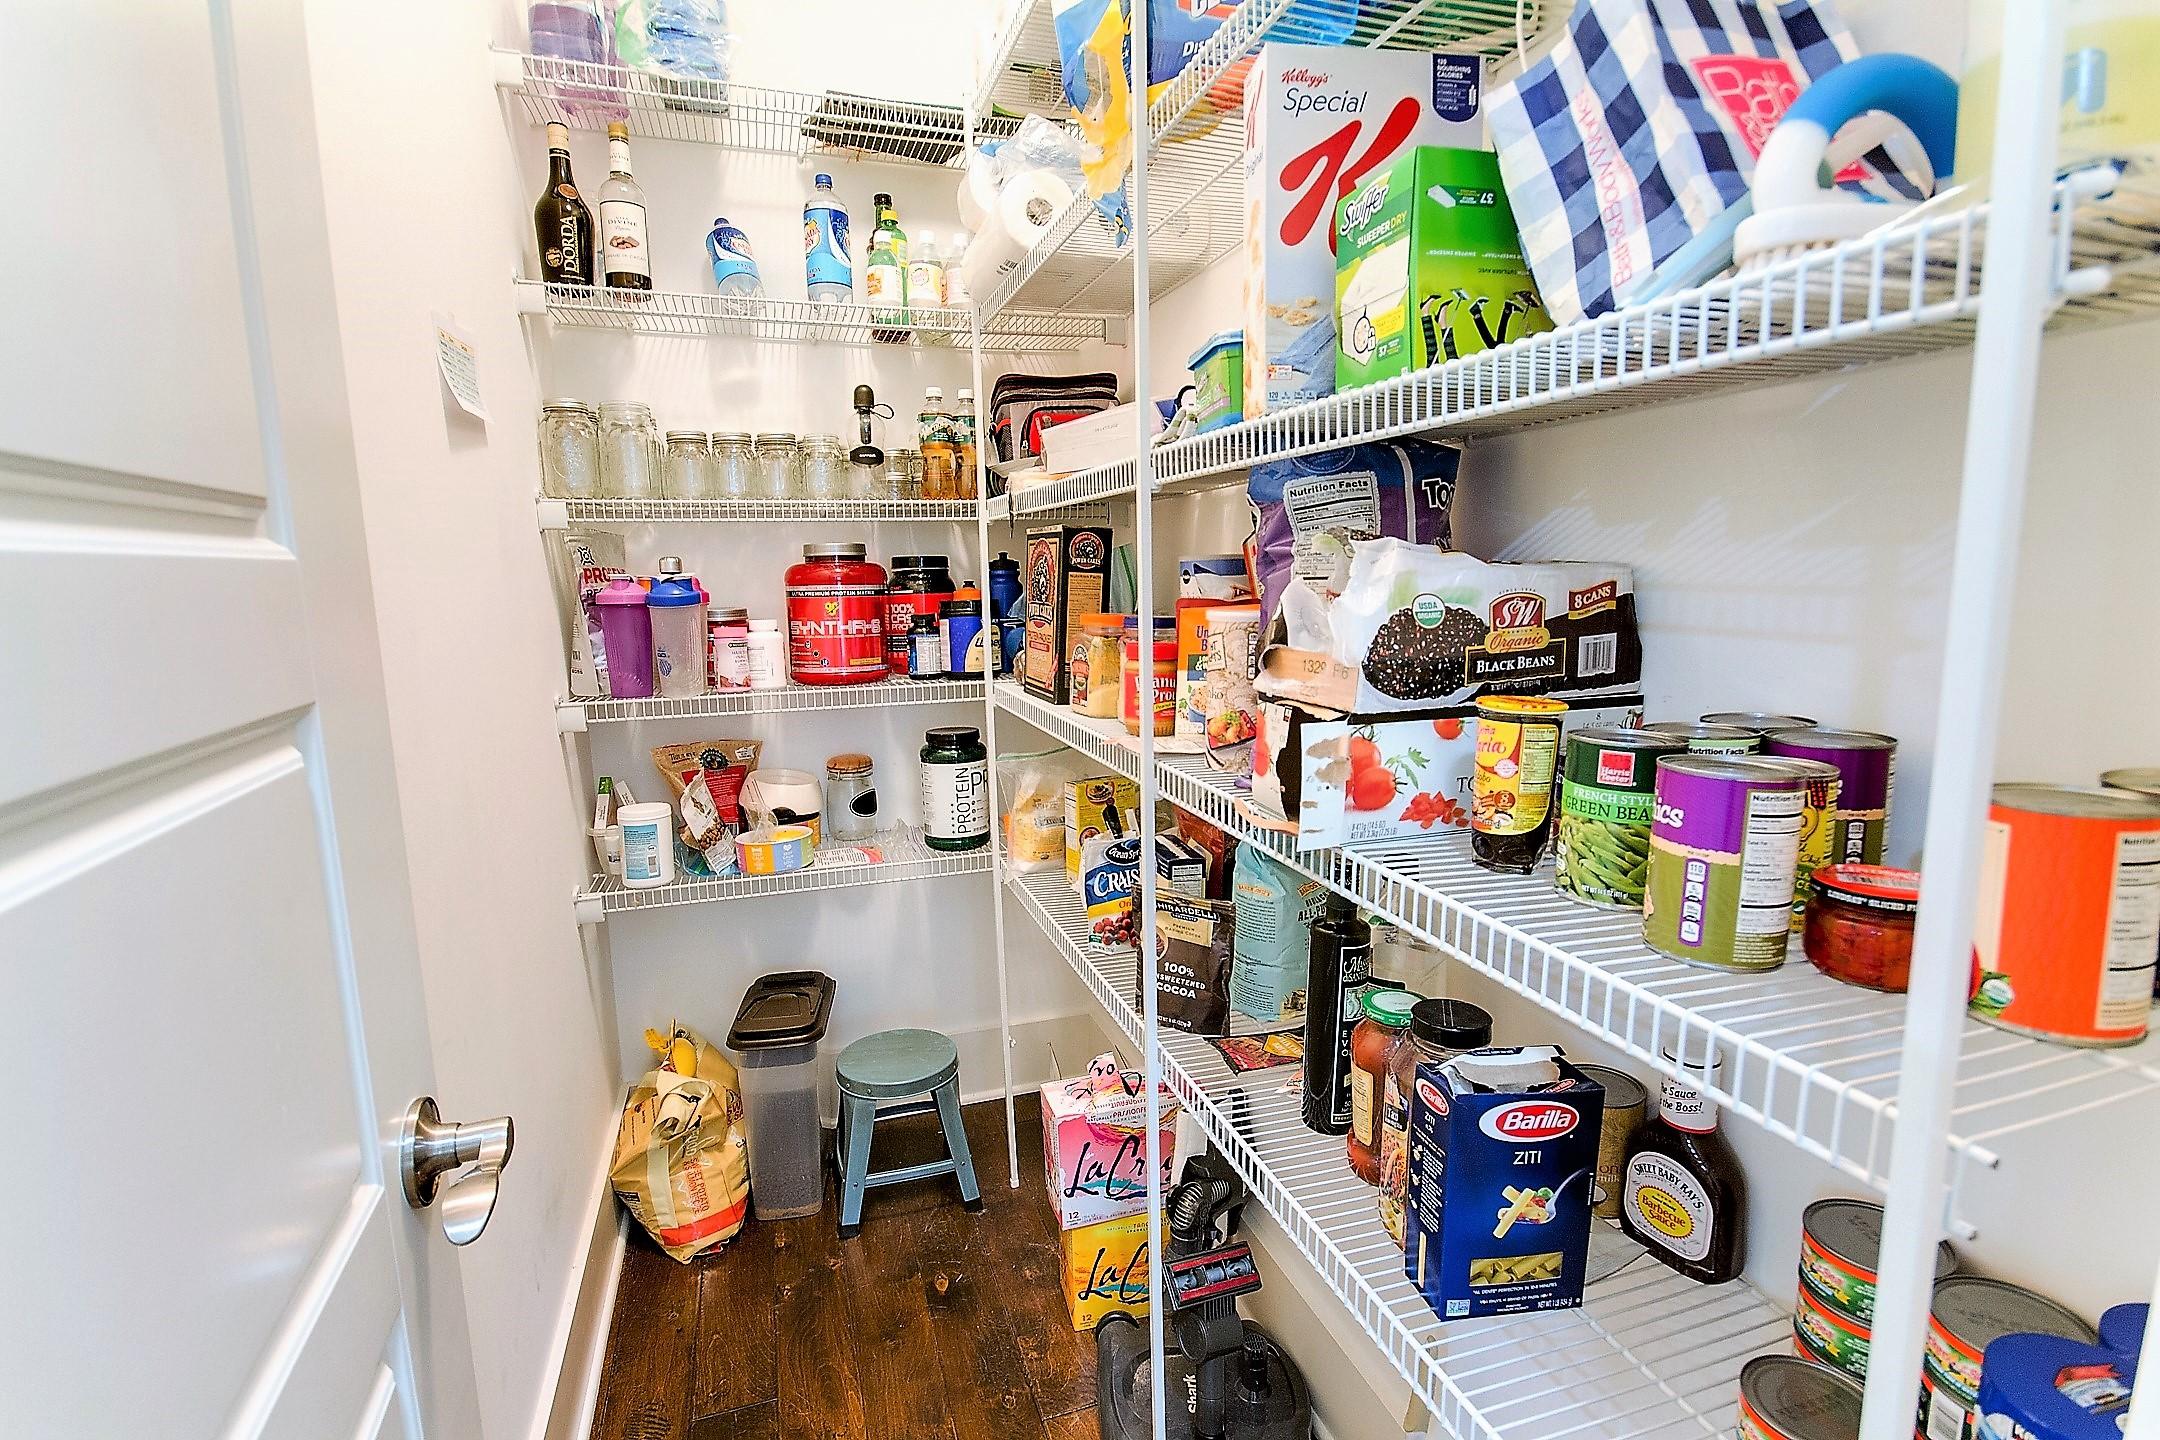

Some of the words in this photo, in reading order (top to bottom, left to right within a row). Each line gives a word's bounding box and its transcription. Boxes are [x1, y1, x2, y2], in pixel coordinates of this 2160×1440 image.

[1281, 67, 1331, 88] Kellogg's
[1282, 86, 1367, 118] Special
[1279, 96, 1421, 257] K
[1480, 192, 1494, 204] 37
[1341, 184, 1388, 234] Swiffer
[1357, 218, 1391, 248] SWEEPER
[1390, 211, 1408, 231] DRY
[560, 215, 576, 273] DORDA
[1289, 481, 1336, 498] Nutrition
[1338, 479, 1369, 489] Facts
[1072, 557, 1086, 565] POWER
[1087, 557, 1101, 565] CAKES
[1418, 601, 1438, 610] USDA
[1574, 594, 1582, 609] 8
[1582, 584, 1612, 604] CANS
[890, 603, 915, 614] 100%
[1416, 611, 1442, 620] ORGANIC
[1496, 597, 1541, 628] S&W
[790, 618, 881, 635] SYNTHA-6
[1489, 631, 1544, 651] Organic
[1476, 659, 1516, 674] BLACK
[1517, 655, 1555, 670] BEANS
[1725, 747, 1745, 756] Facts
[1601, 767, 1631, 777] Harris
[954, 767, 972, 834] PROTEIN
[1501, 794, 1509, 804] 8
[1573, 786, 1618, 803] FRENCH
[1619, 795, 1656, 806] STYL
[1752, 793, 1792, 802] Nutrition
[1565, 795, 1611, 819] GREEN
[1616, 805, 1651, 822] BEA
[1108, 847, 1129, 860] Ocean
[1093, 868, 1141, 898] CRAIS
[1155, 902, 1218, 920] HIRARDELLI
[1163, 961, 1195, 977] 100%
[1156, 981, 1197, 999] COCOA
[1422, 1084, 1447, 1112] Barilla
[1668, 1085, 1697, 1099] Sauce
[1675, 1101, 1704, 1113] Boss!
[1424, 1111, 1435, 1126] ZITI
[1503, 1109, 1572, 1131] Barilla
[1512, 1150, 1542, 1166] ZITI
[1633, 1162, 1657, 1176] SWEET
[1657, 1165, 1681, 1187] BABY
[1679, 1182, 1705, 1209] RAY'S
[698, 1181, 710, 1213] POTATO
[1068, 1211, 1080, 1220] 12
[1641, 1194, 1686, 1229] Barbecue
[1648, 1209, 1677, 1230] Sauce
[1082, 1313, 1093, 1323] 12
